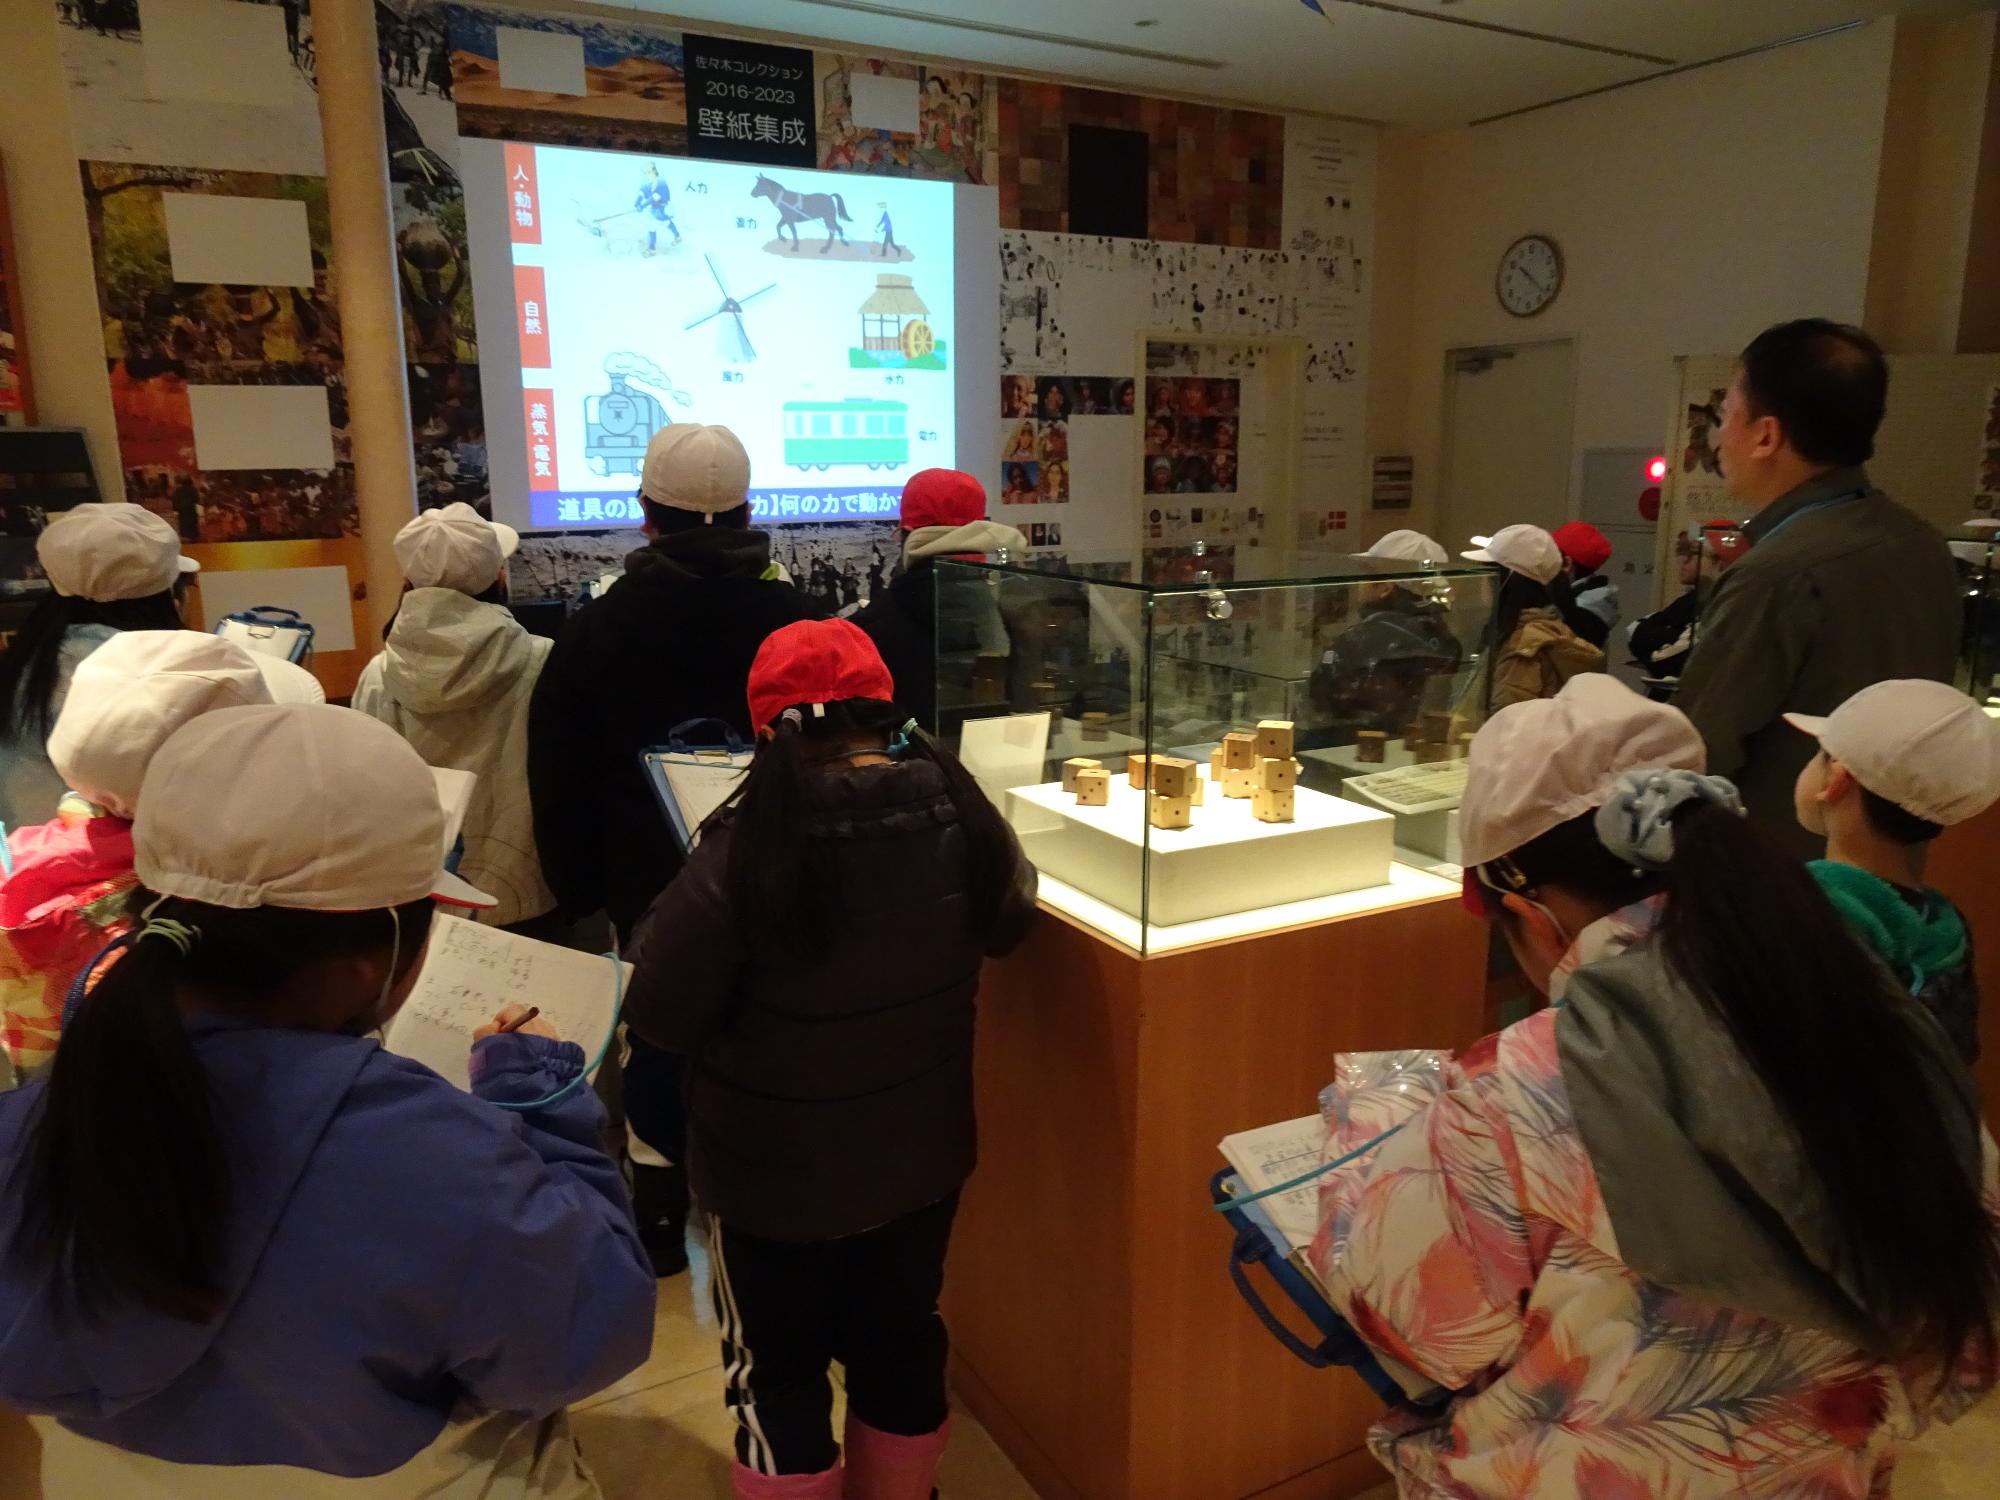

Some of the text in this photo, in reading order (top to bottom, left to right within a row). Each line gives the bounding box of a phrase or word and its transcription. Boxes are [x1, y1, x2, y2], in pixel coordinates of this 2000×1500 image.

[695, 55, 804, 80] 佐々木コレクション
[706, 80, 796, 105] 2016-2023
[698, 107, 807, 147] 壁紙集成
[513, 163, 533, 227] 人・動物
[686, 181, 708, 194] 人力
[524, 300, 542, 335] 自然
[750, 492, 903, 516] 力】何の力で動か
